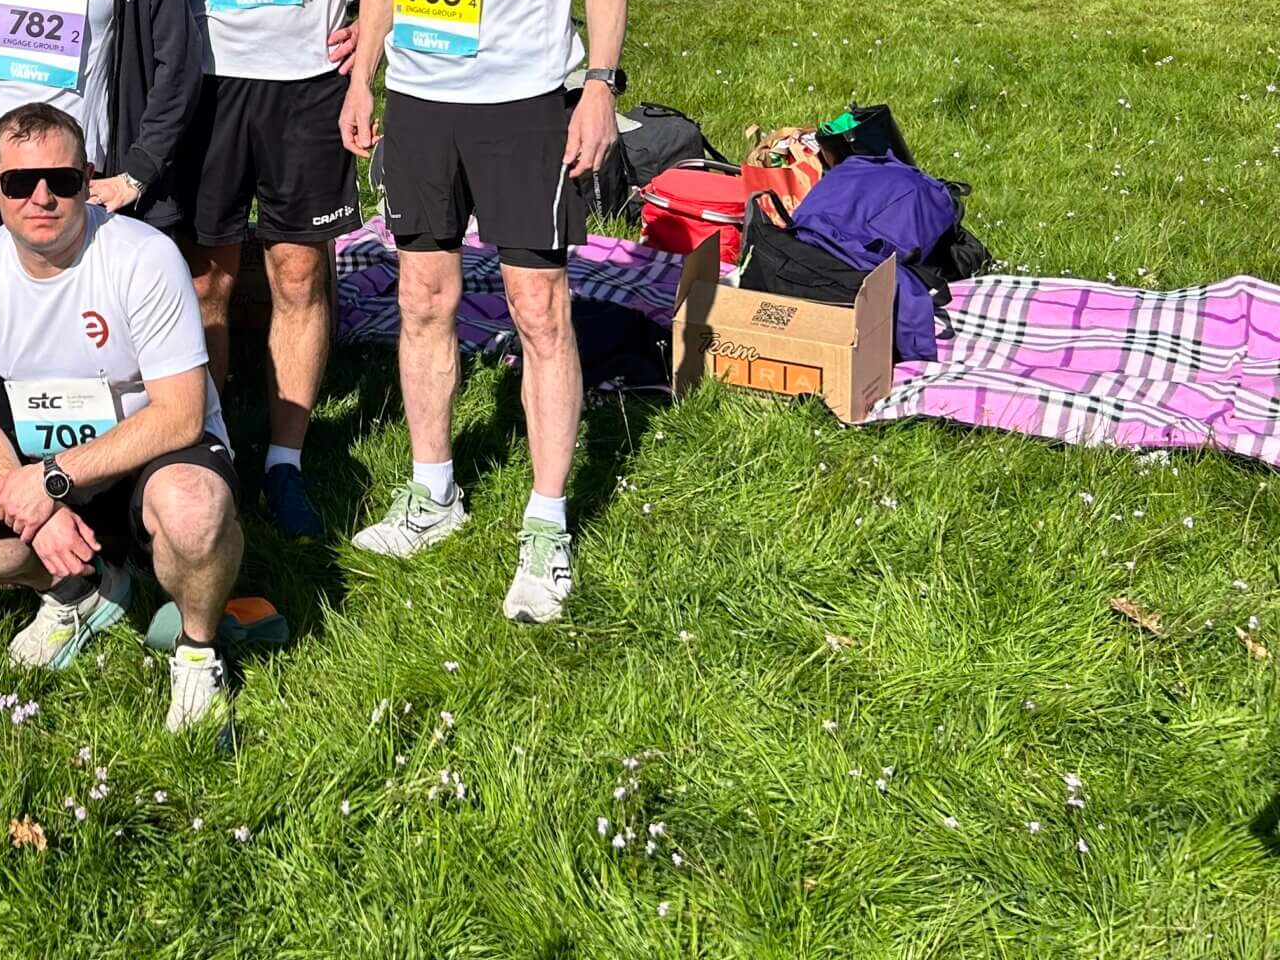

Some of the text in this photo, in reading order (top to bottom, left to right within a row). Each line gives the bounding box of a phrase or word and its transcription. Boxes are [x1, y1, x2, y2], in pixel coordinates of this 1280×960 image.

[9, 9, 80, 44] 782 2
[312, 207, 345, 226] CRAFT
[698, 332, 761, 363] Team
[27, 392, 63, 410] stc
[34, 423, 97, 450] 708
